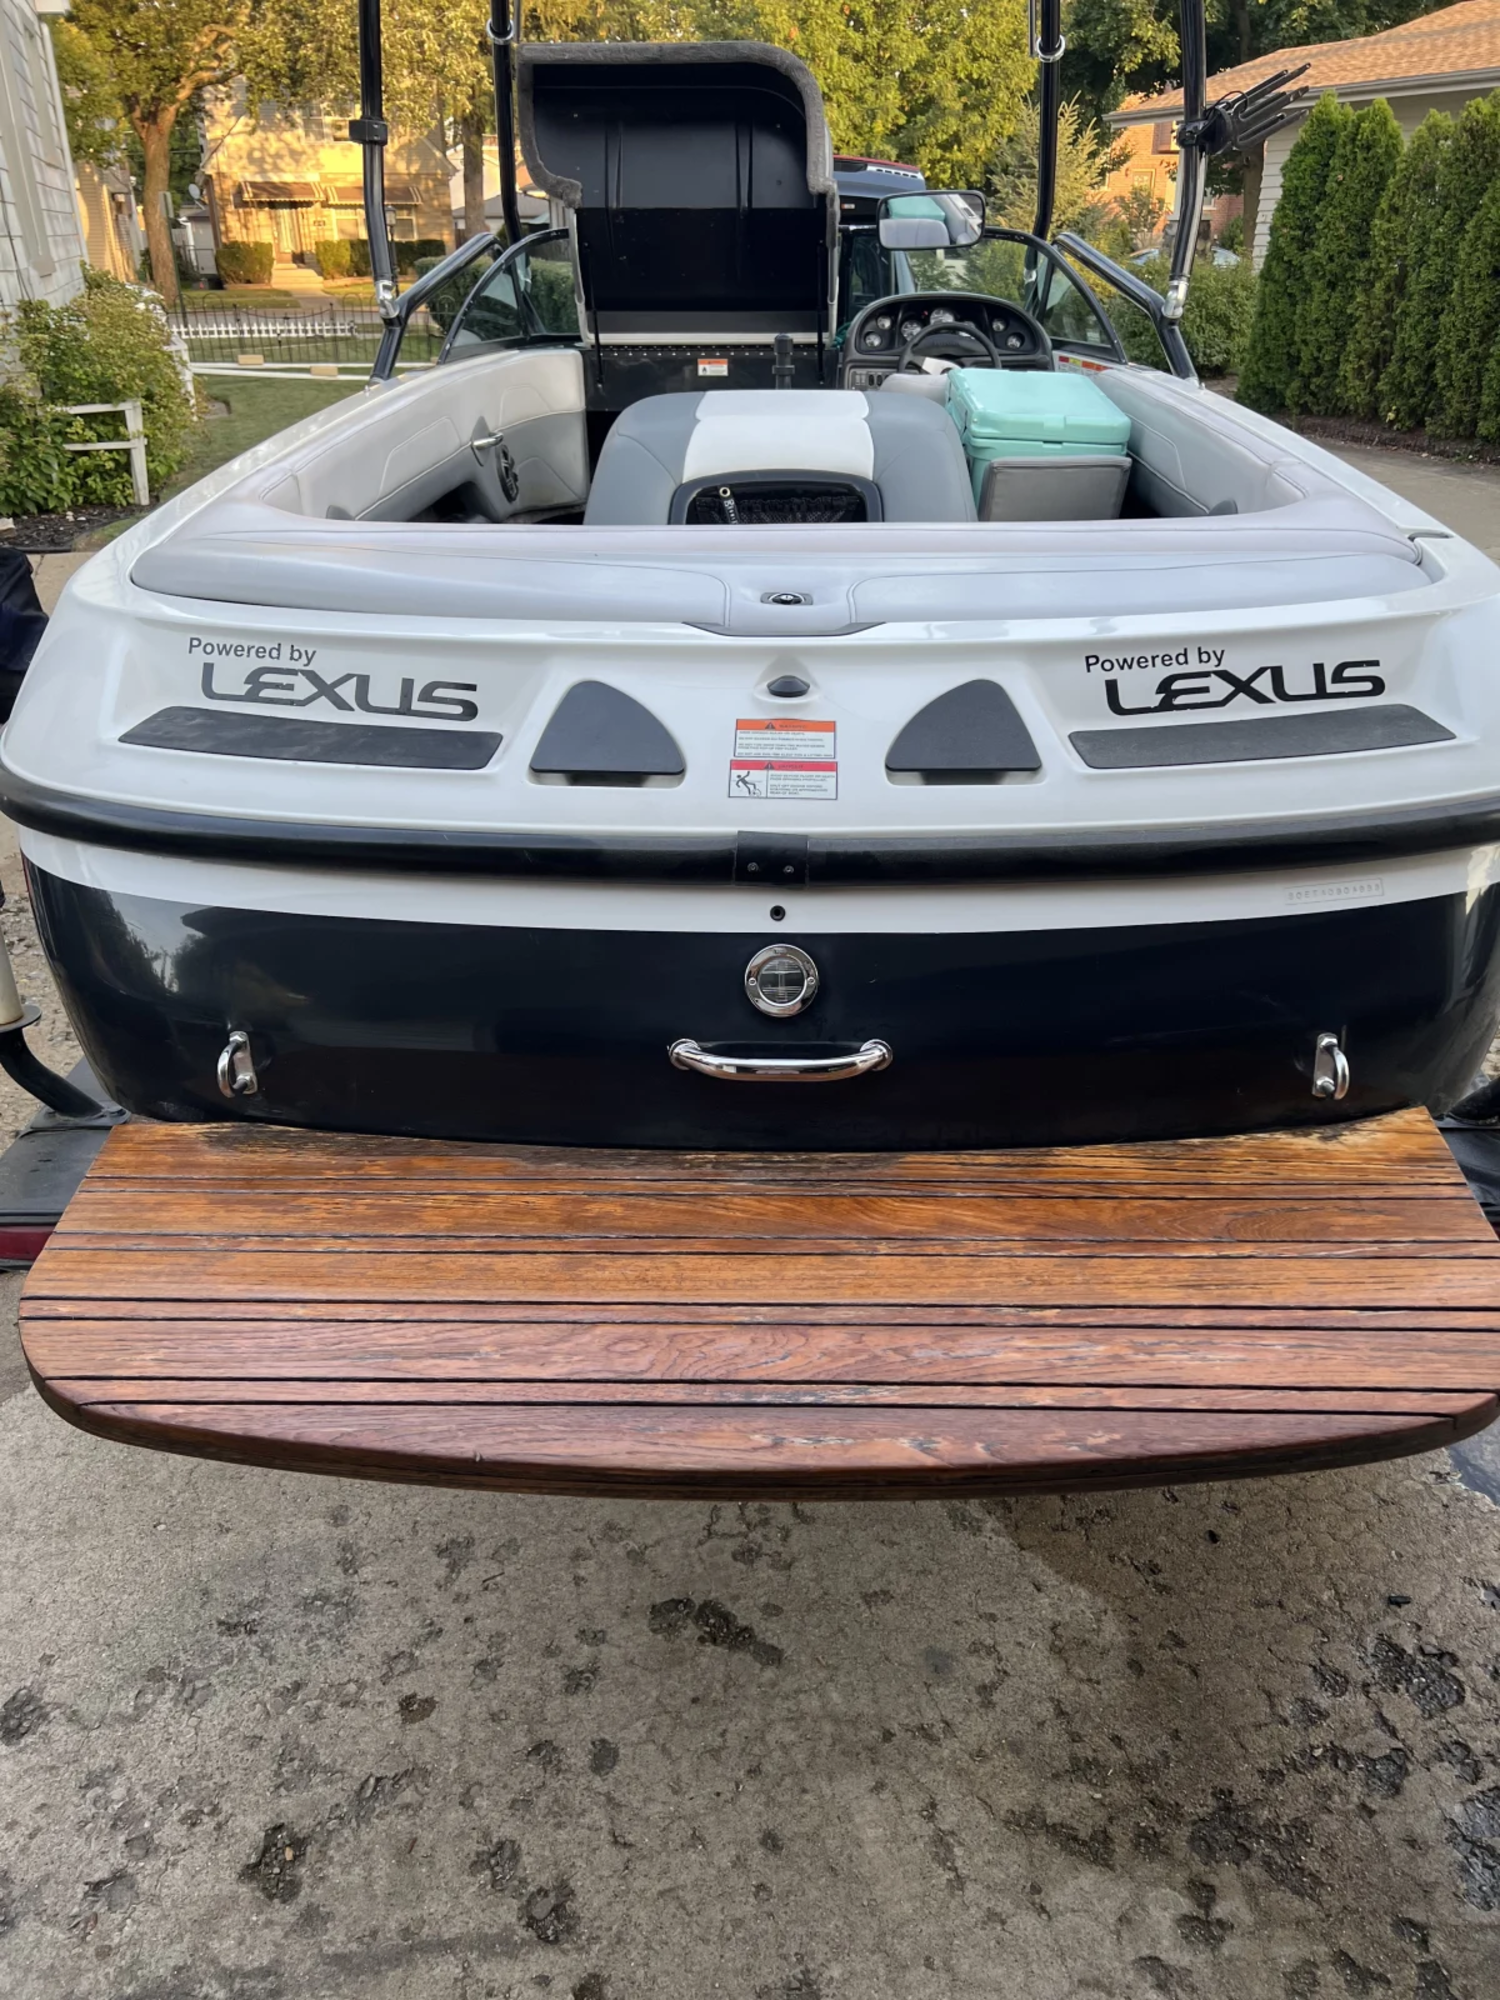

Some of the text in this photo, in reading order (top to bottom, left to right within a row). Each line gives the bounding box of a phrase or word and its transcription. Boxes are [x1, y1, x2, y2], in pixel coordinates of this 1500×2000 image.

[188, 636, 317, 666] Powered by
[1085, 646, 1226, 673] Powered by
[201, 662, 478, 721] LEXUS
[1104, 660, 1386, 716] LEXUS
